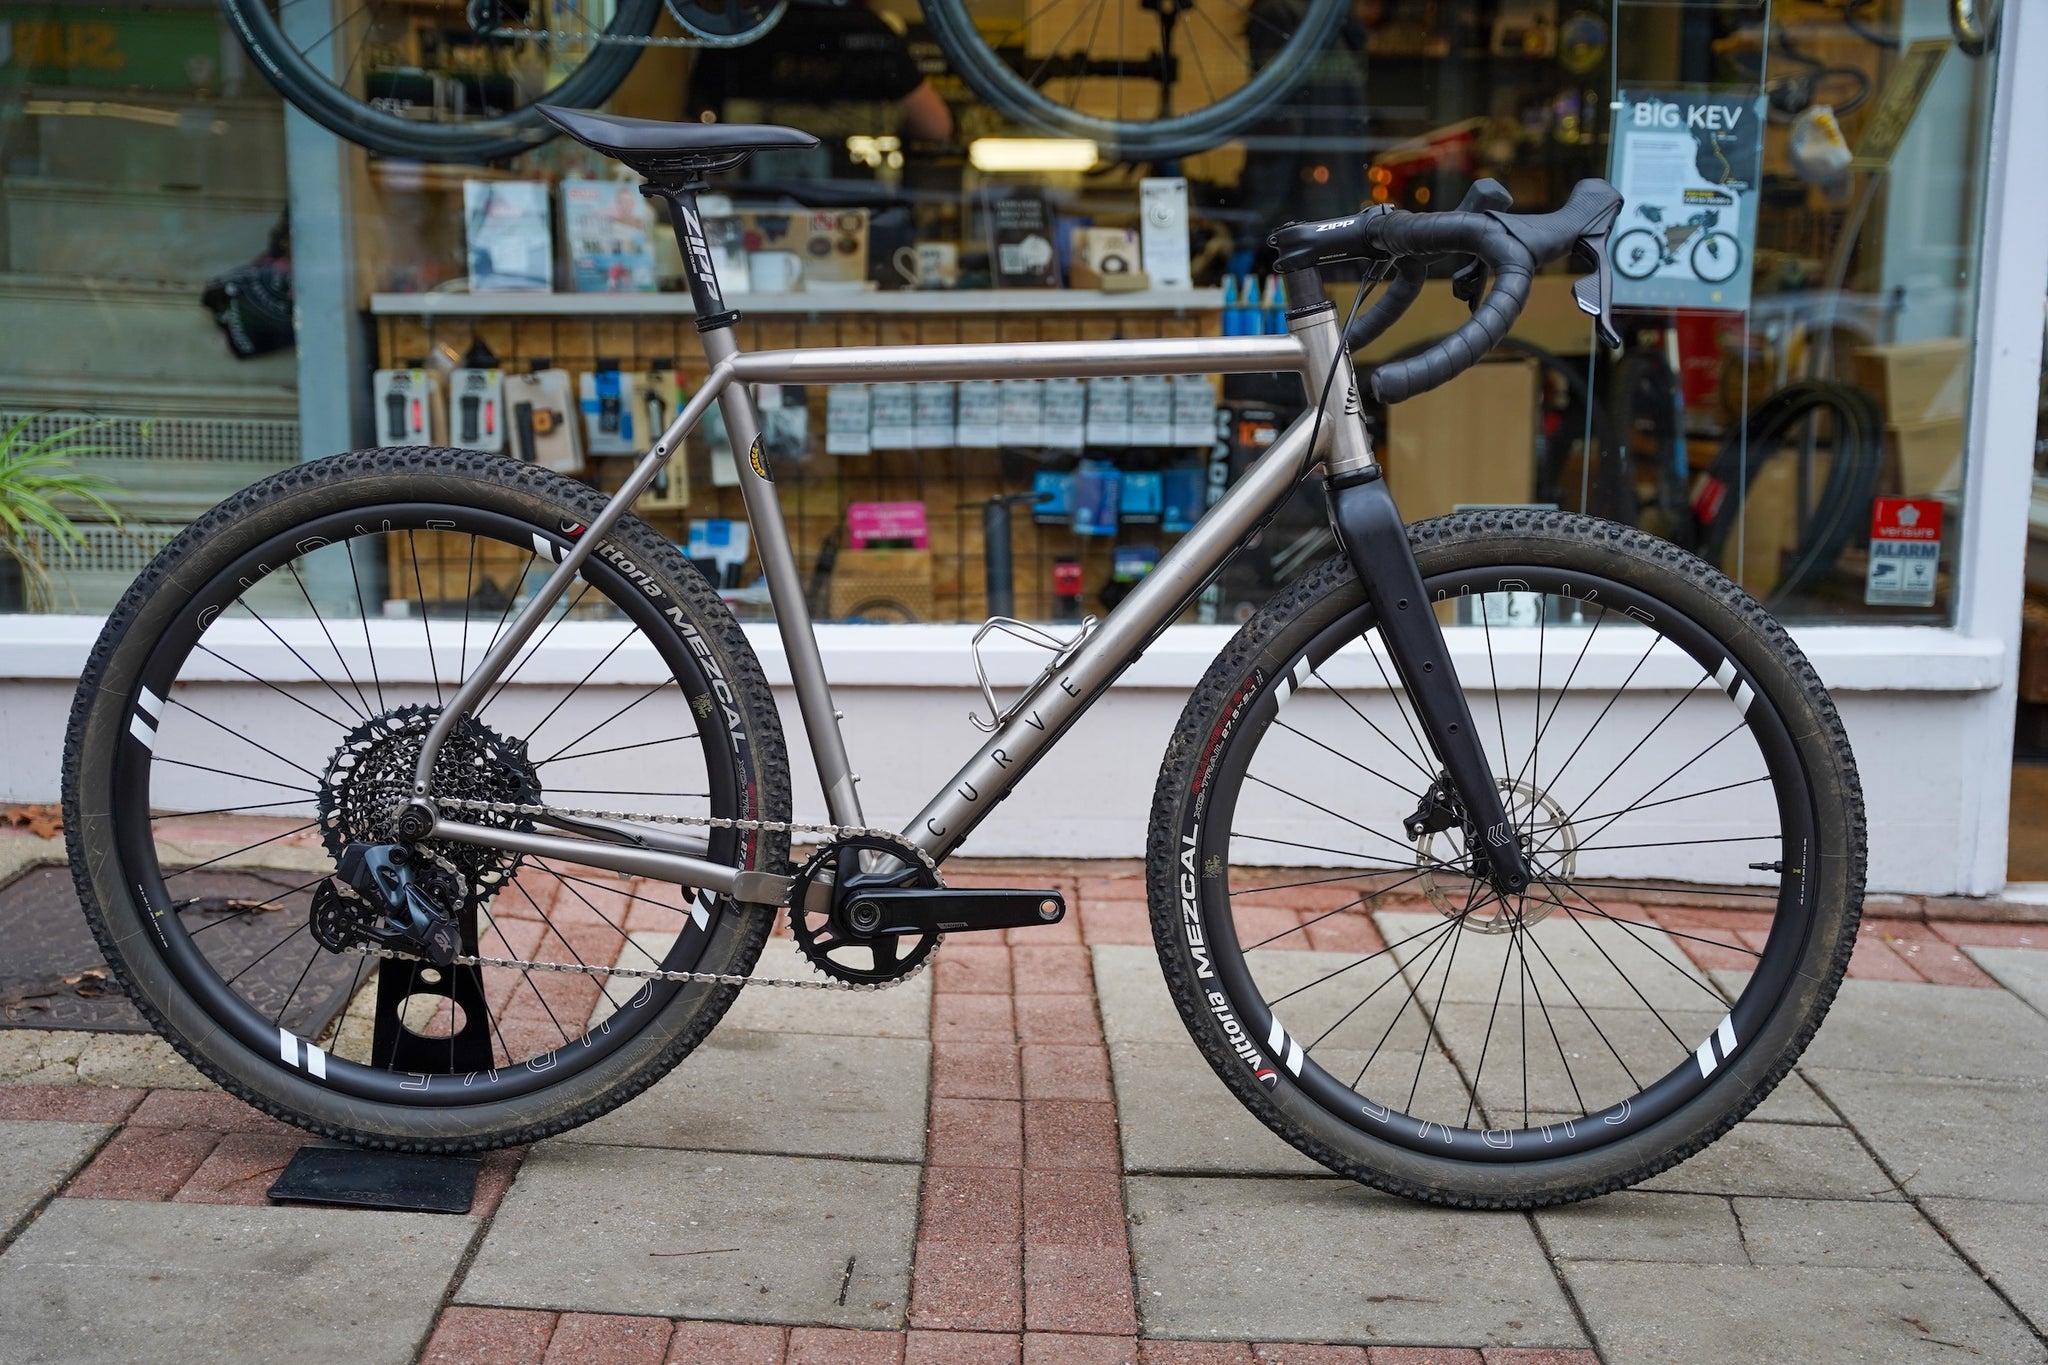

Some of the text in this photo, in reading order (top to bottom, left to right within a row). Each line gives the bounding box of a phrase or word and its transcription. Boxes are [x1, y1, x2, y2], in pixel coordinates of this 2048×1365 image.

[1633, 102, 1743, 130] BIG KEV
[681, 206, 719, 301] ZIPP
[1315, 219, 1355, 232] ZIPP
[1874, 542, 1937, 558] ALARM
[1879, 526, 1935, 538] verisure
[593, 539, 747, 753] ittoria MEZCAL
[927, 676, 1082, 837] CURVE
[1180, 823, 1214, 979] MEZCAL
[1207, 992, 1261, 1072] vittoria
